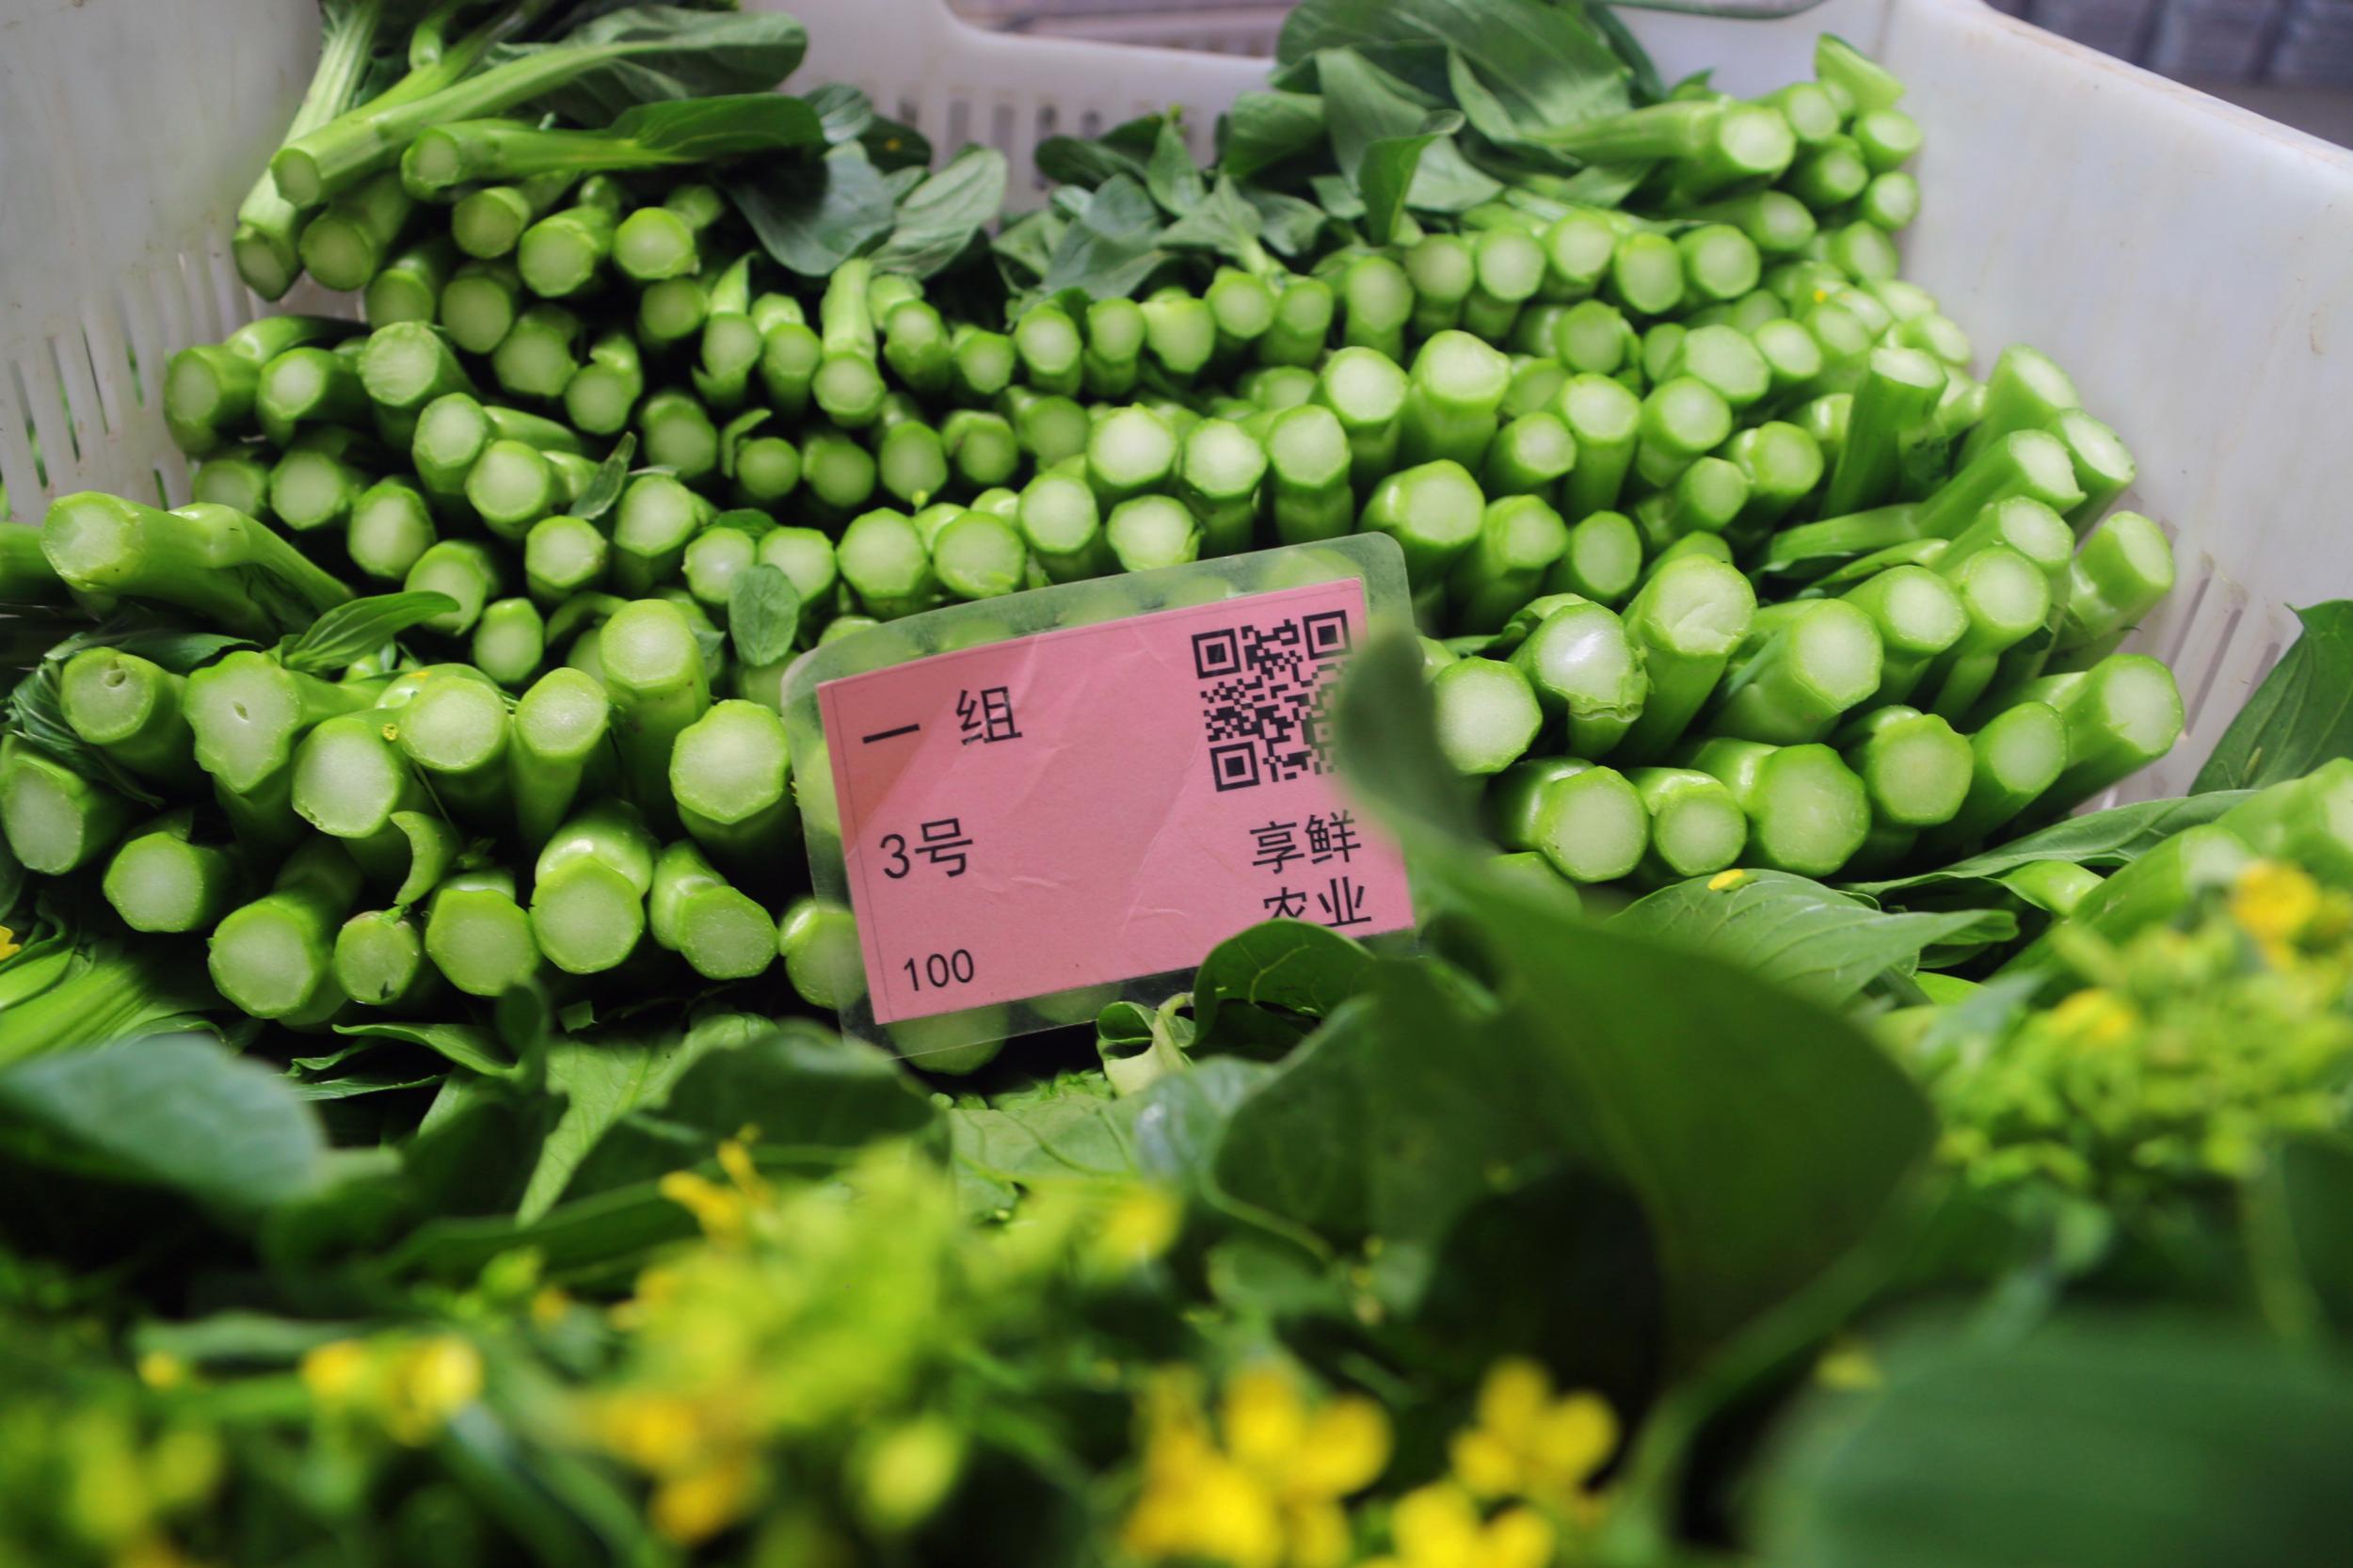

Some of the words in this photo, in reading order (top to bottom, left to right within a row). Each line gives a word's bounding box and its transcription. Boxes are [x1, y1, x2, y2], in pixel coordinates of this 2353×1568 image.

[862, 686, 1022, 744] 一组
[880, 818, 973, 879] 3号
[1250, 809, 1361, 873] 享鲜
[904, 949, 974, 991] 100
